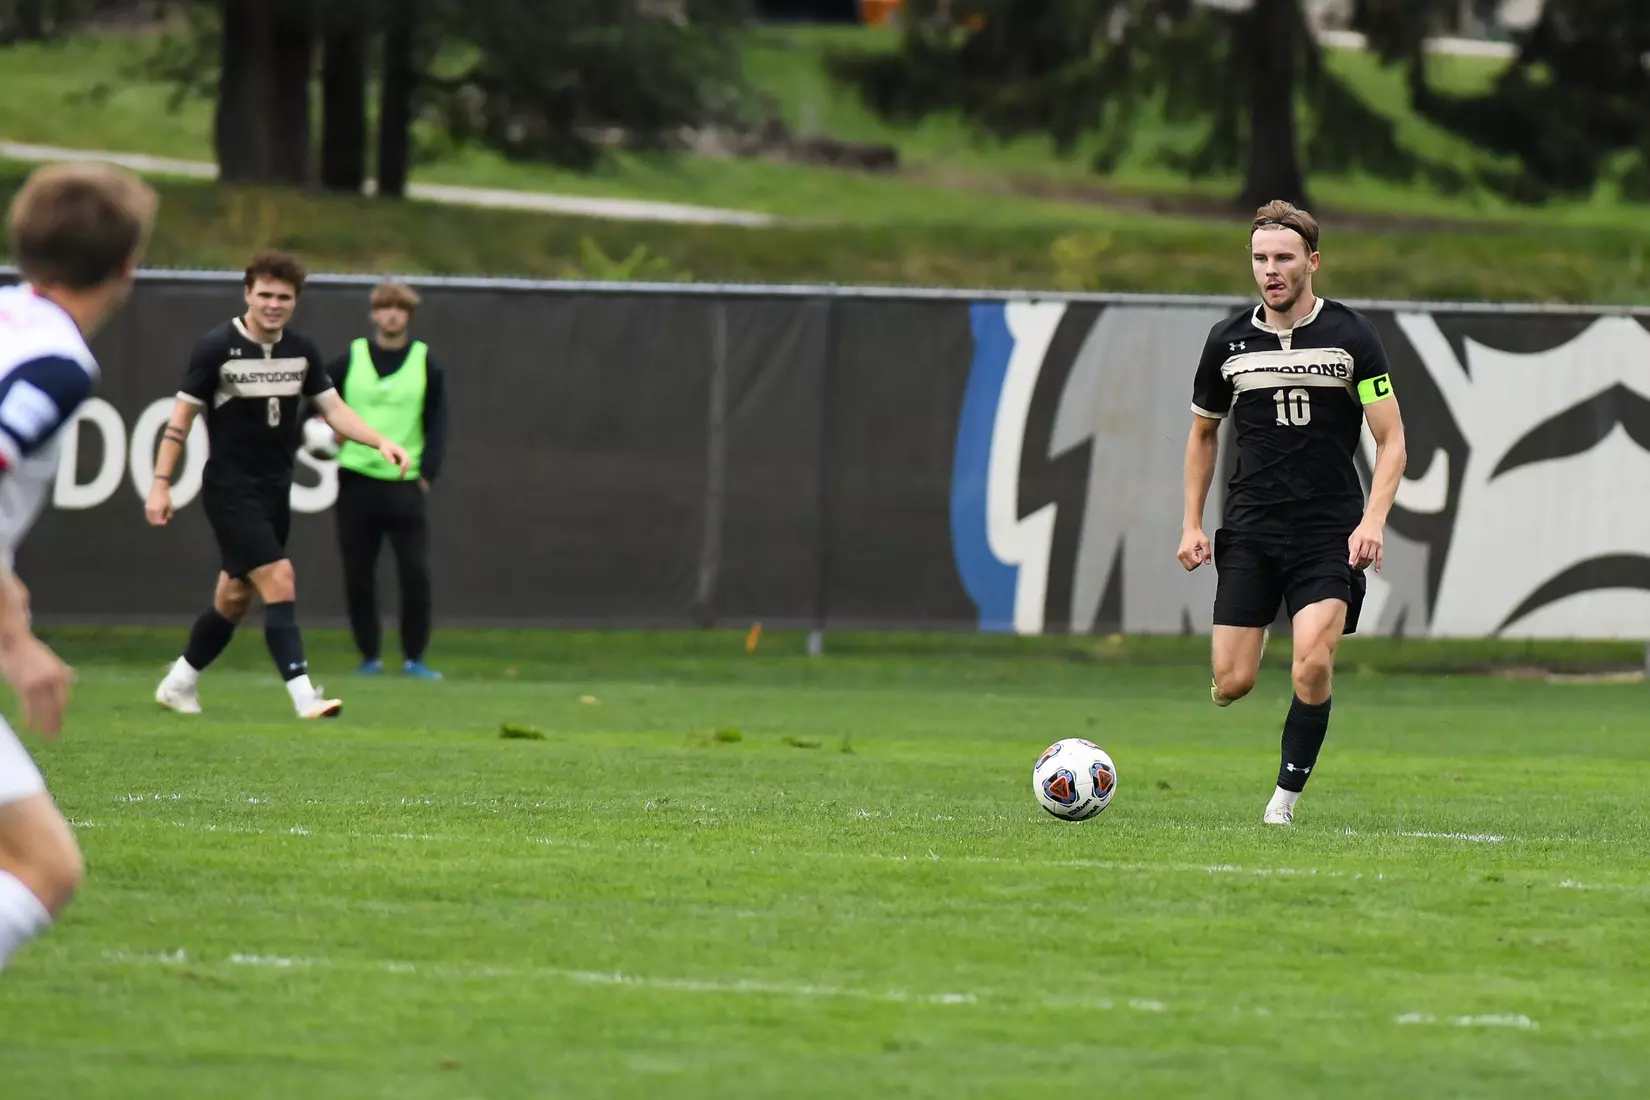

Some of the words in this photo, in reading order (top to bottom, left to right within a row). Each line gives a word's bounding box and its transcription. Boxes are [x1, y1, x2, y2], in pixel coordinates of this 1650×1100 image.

[1227, 363, 1347, 379] ODONS
[1373, 376, 1389, 398] C
[1273, 388, 1312, 426] 10
